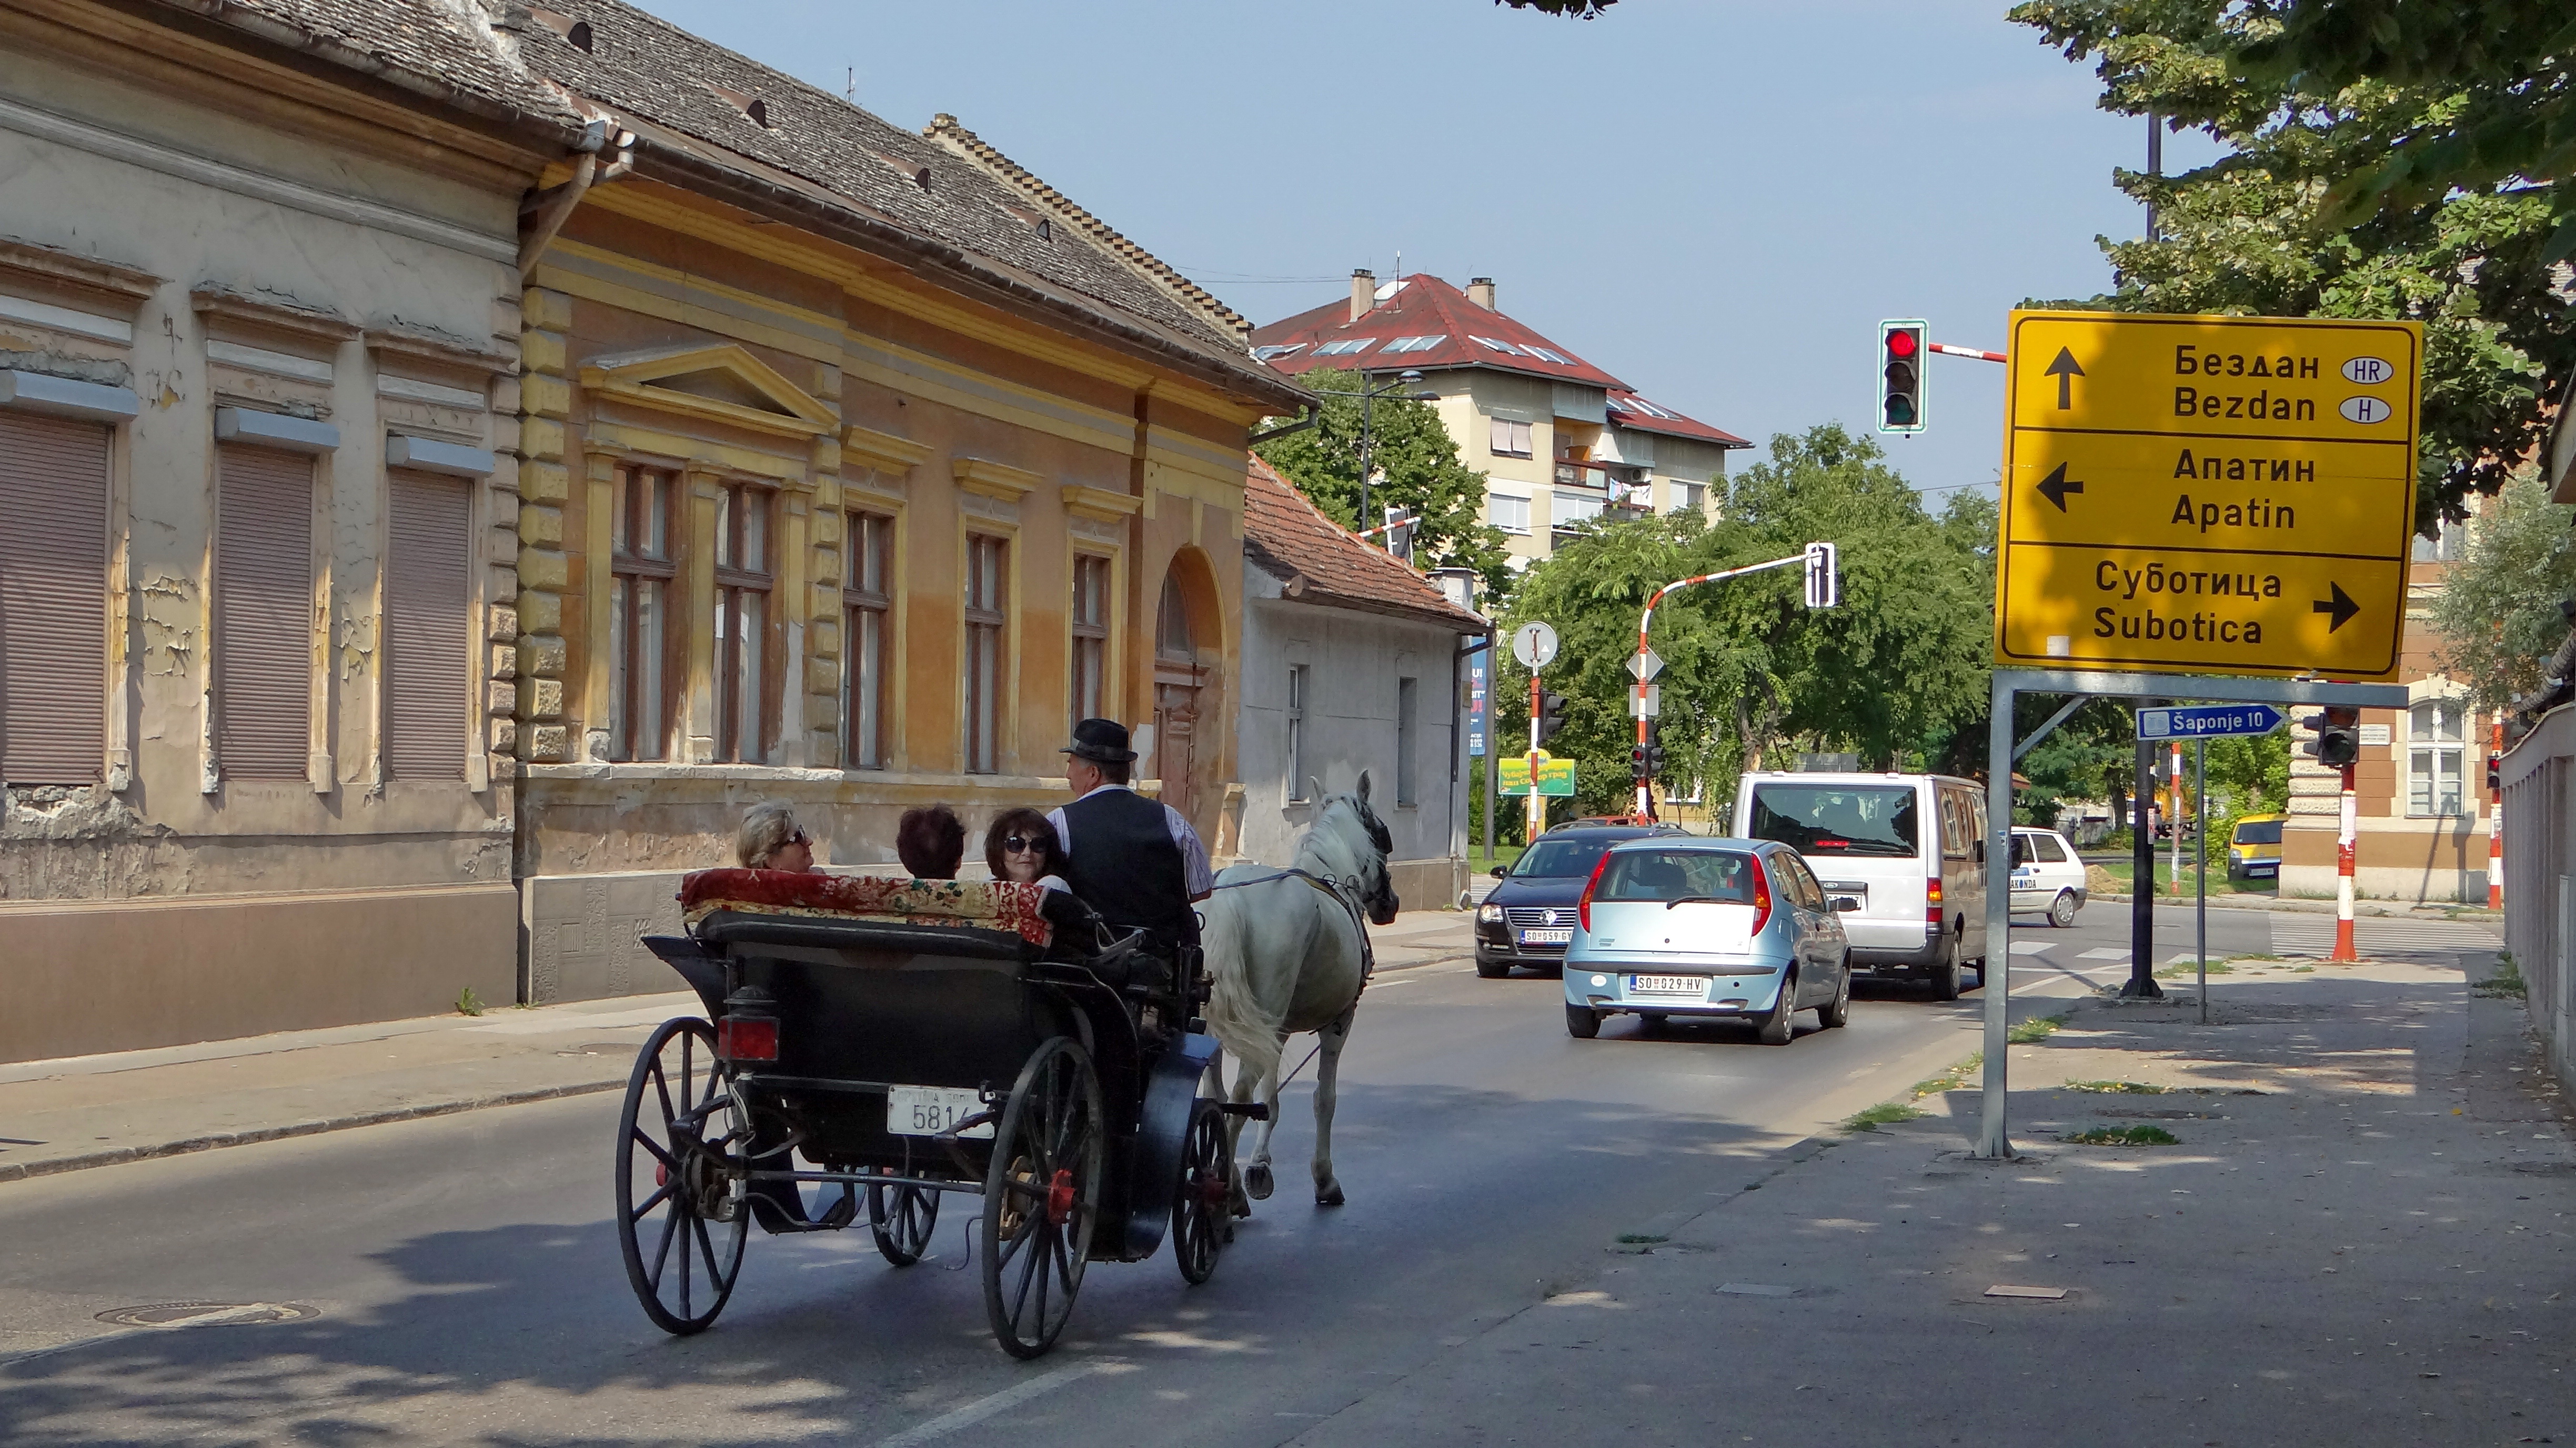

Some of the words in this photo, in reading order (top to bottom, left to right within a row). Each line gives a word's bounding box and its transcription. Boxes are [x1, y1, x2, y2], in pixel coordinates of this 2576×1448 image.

[2175, 345, 2319, 379] Бездан
[2354, 360, 2381, 383] HR
[2175, 386, 2315, 421] Bezdan
[2358, 399, 2371, 421] H
[2173, 448, 2314, 483] Апатин
[2170, 494, 2295, 534] Apatin
[2096, 560, 2281, 602] Суботица
[2094, 607, 2261, 644] Subotica
[2173, 711, 2242, 733] Šaponje
[2247, 711, 2263, 727] 10
[1527, 932, 1536, 941] SO
[1638, 977, 1652, 989] SO
